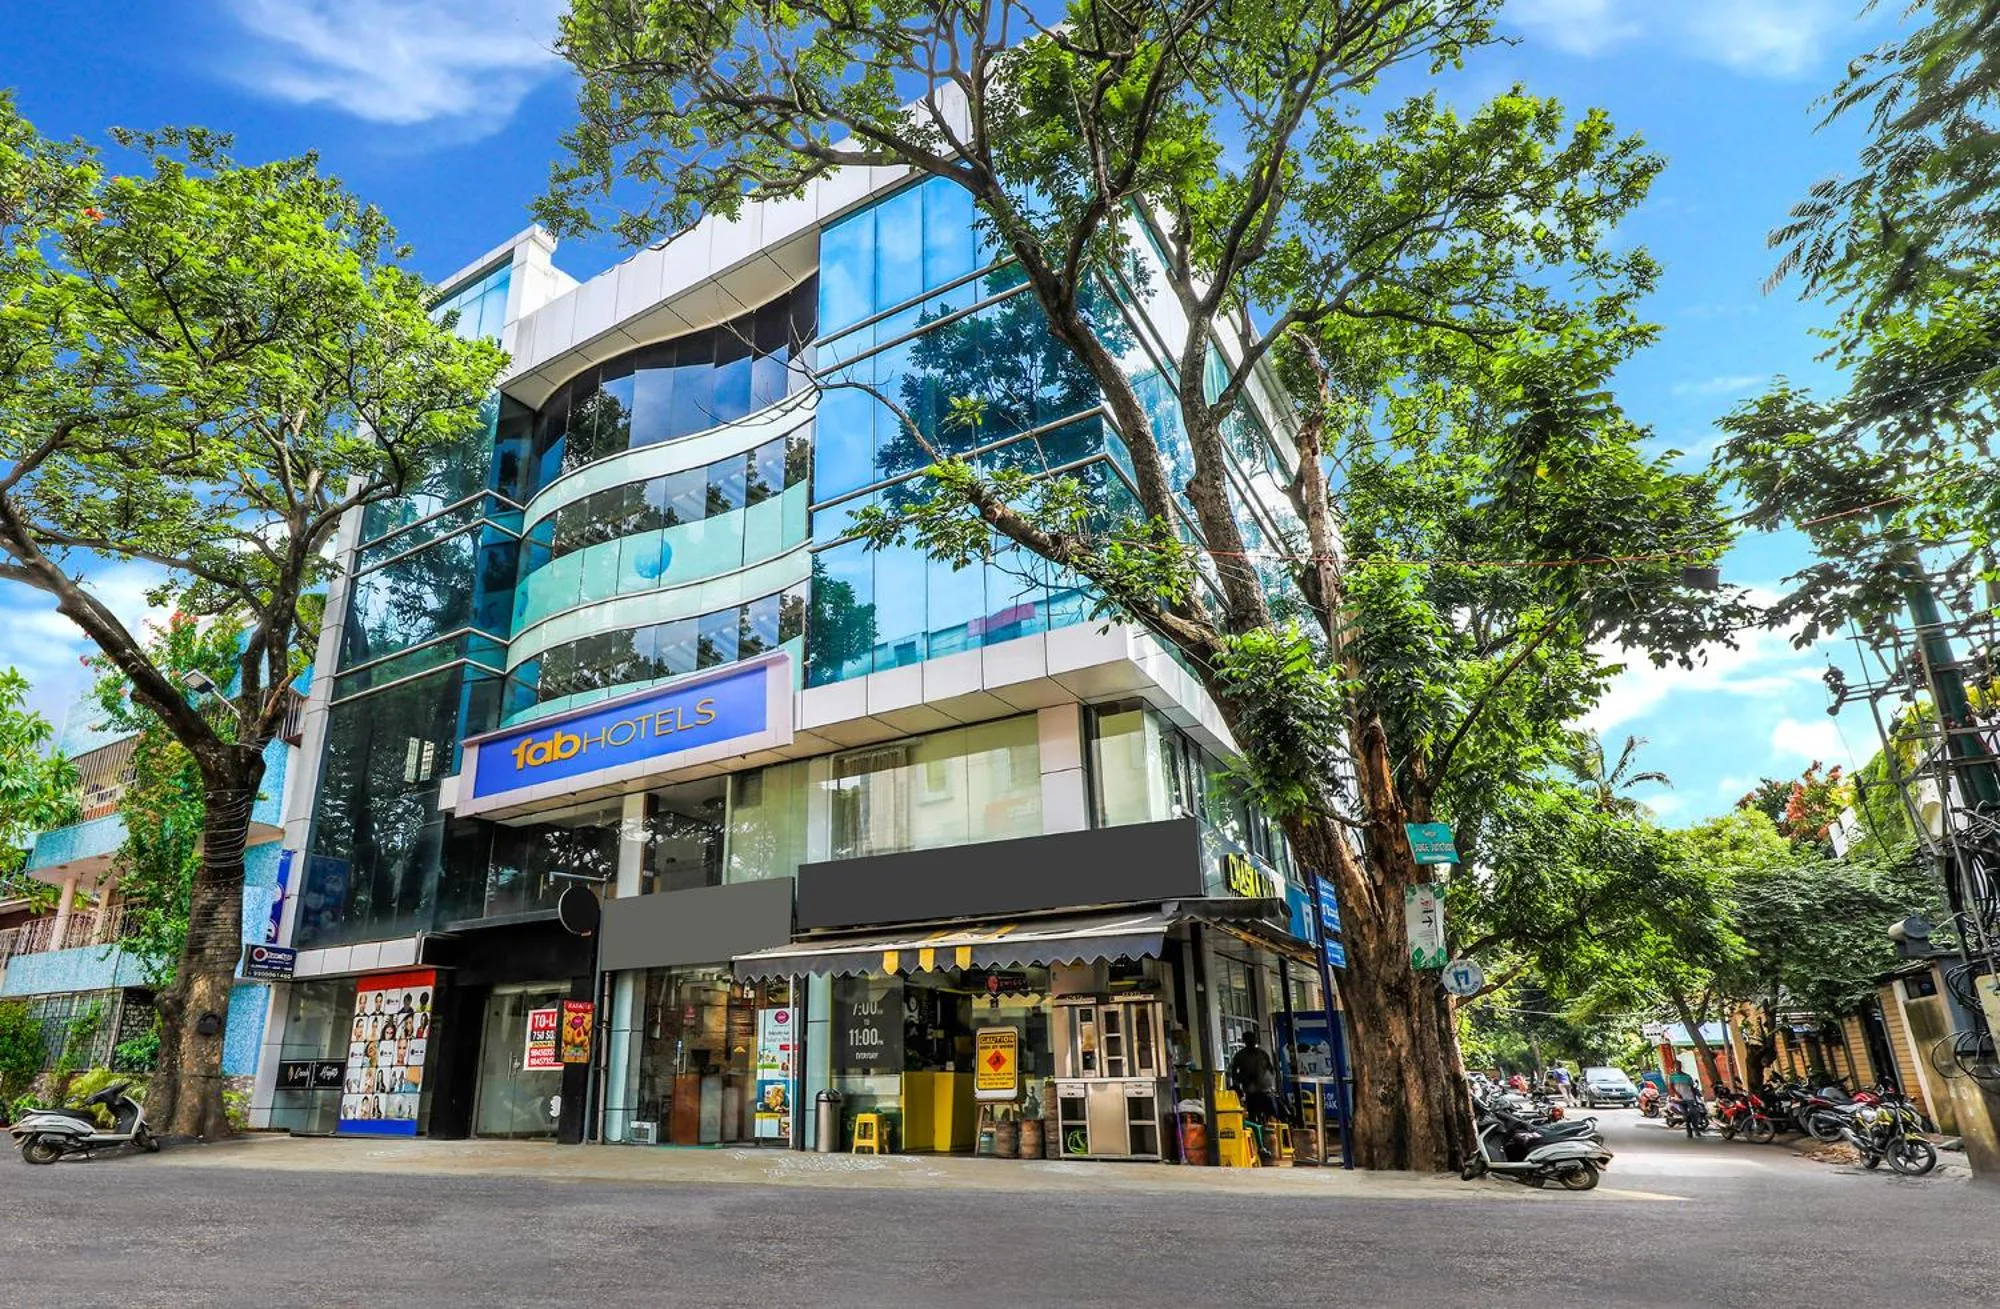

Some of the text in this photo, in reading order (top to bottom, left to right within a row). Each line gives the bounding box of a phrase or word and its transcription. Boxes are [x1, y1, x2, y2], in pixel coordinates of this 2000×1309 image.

[534, 1013, 557, 1028] TO-L
[848, 1028, 878, 1046] 11:00
[980, 1036, 1014, 1044] CAUTION
